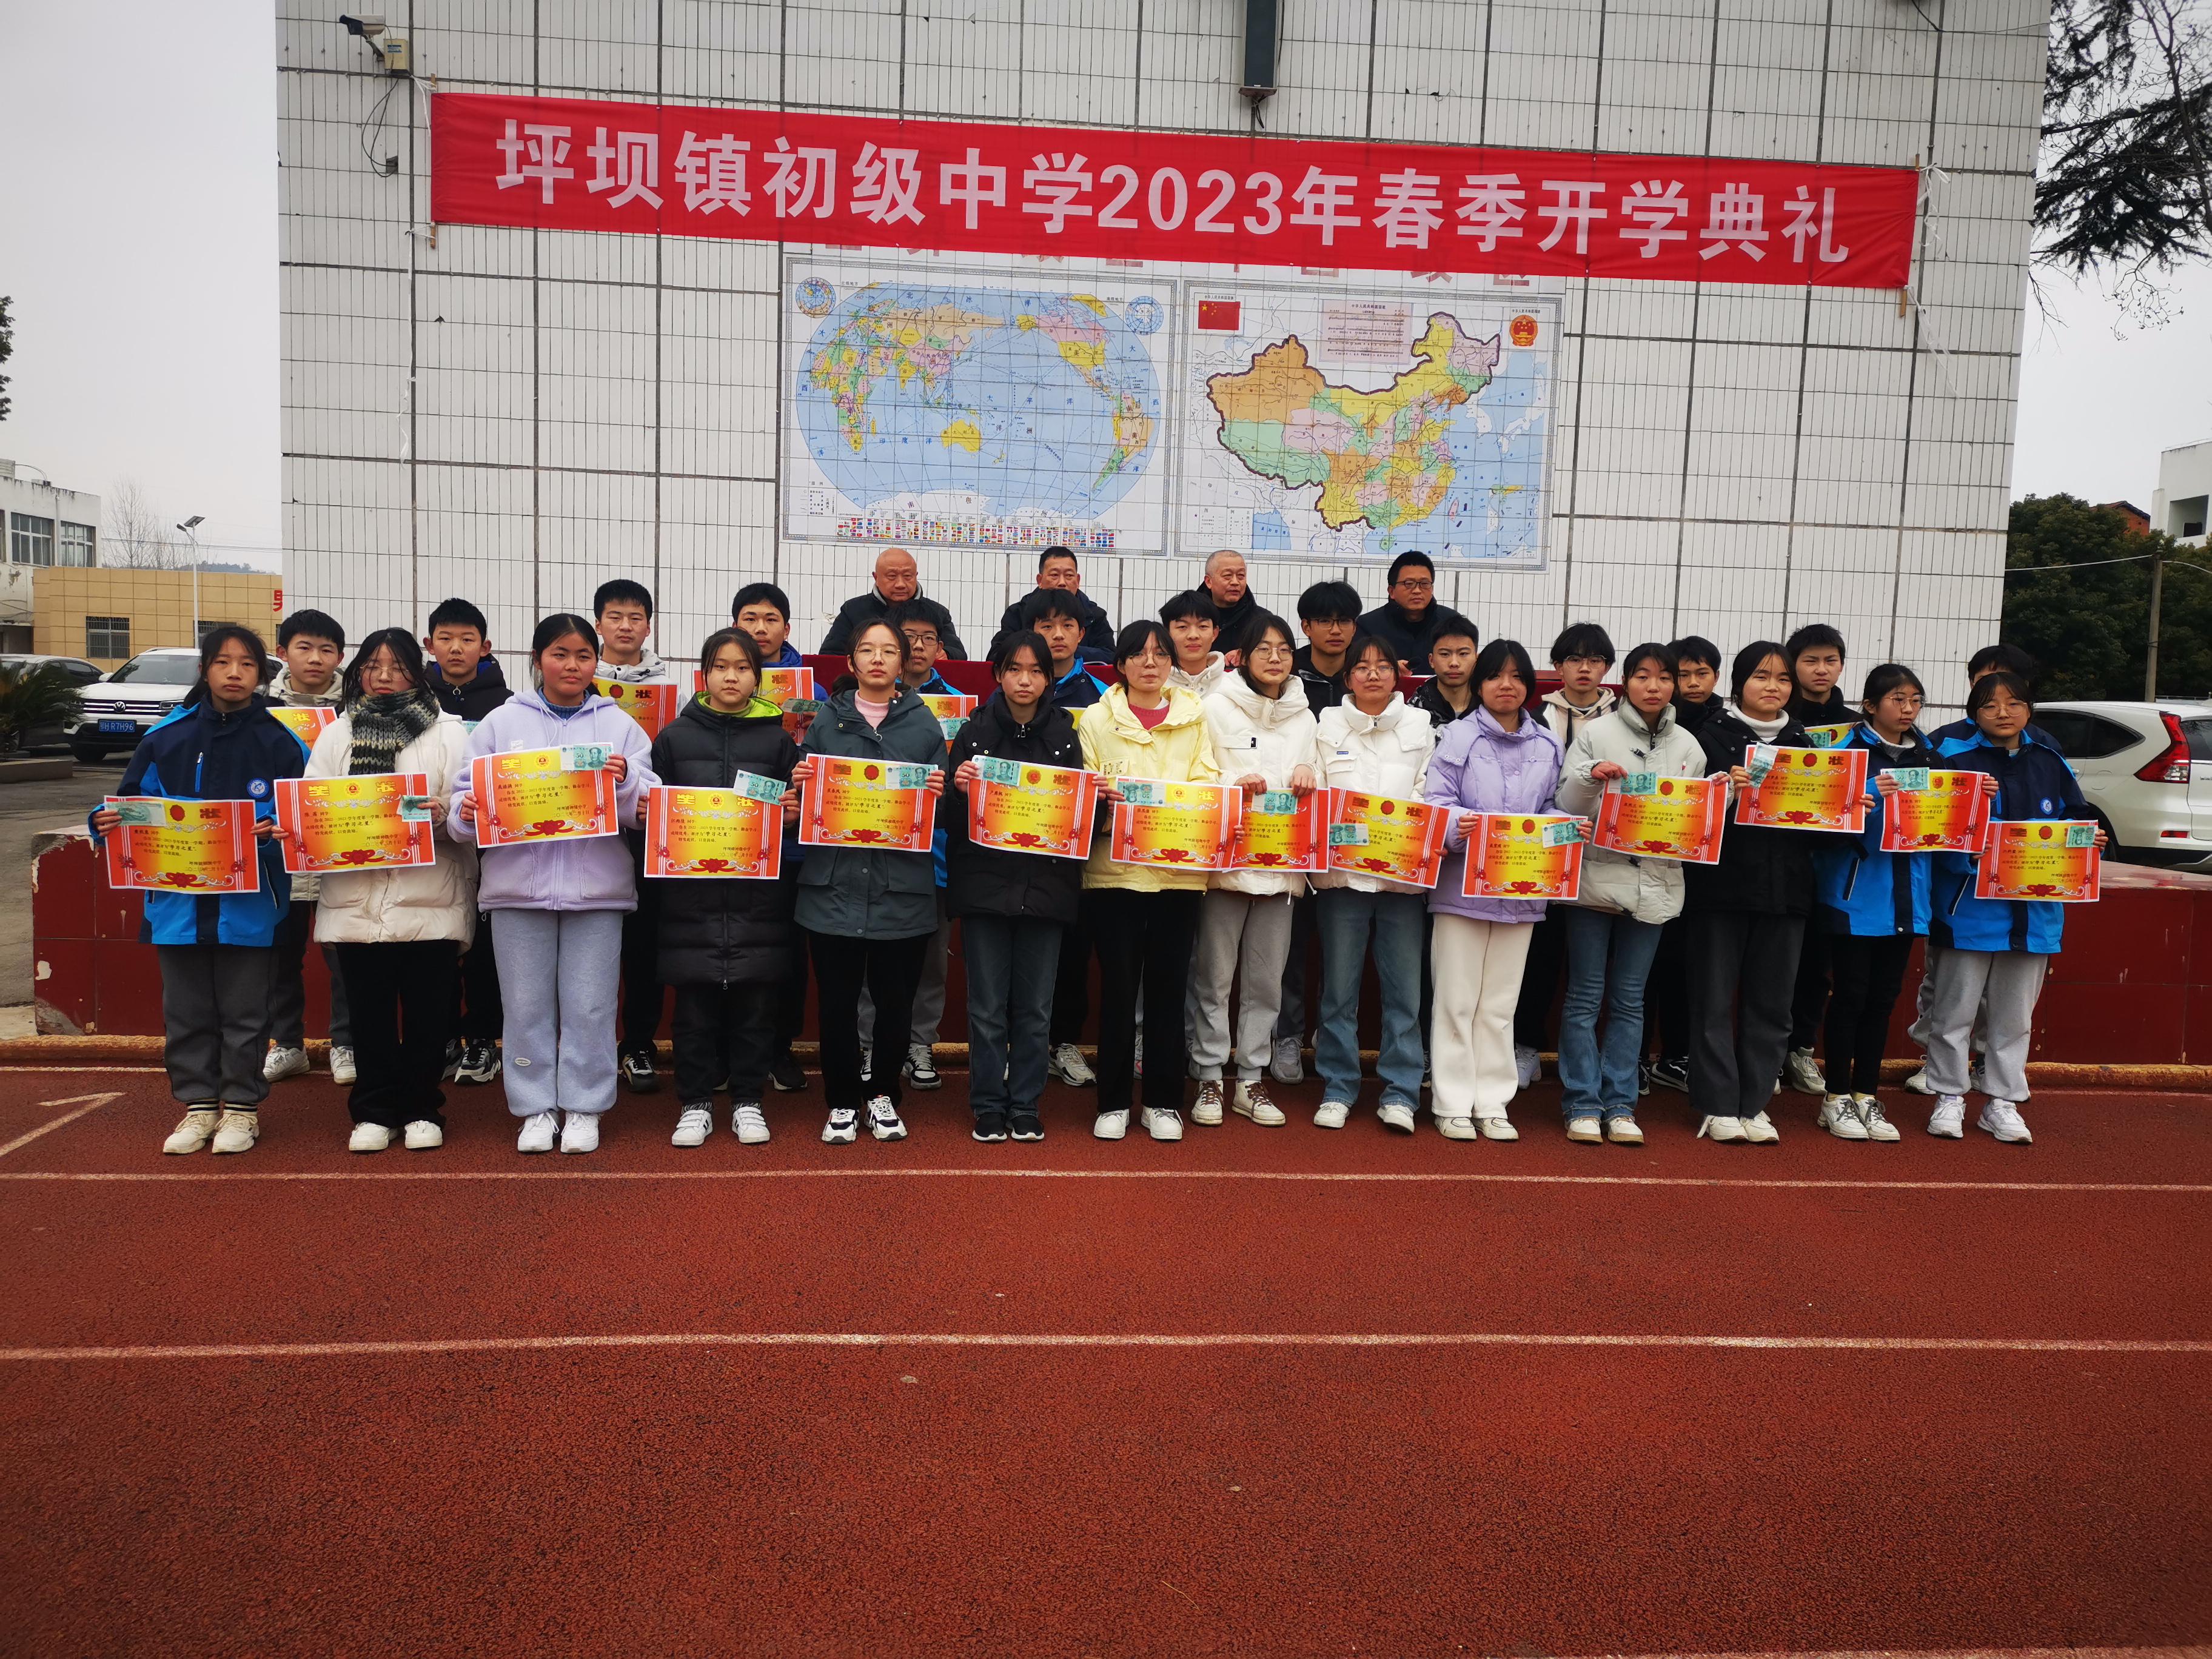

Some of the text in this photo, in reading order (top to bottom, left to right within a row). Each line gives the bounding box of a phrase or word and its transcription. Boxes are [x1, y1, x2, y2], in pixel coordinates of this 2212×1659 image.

[496, 119, 1849, 263] 坪坝镇初级中学2023年春季开学典礼
